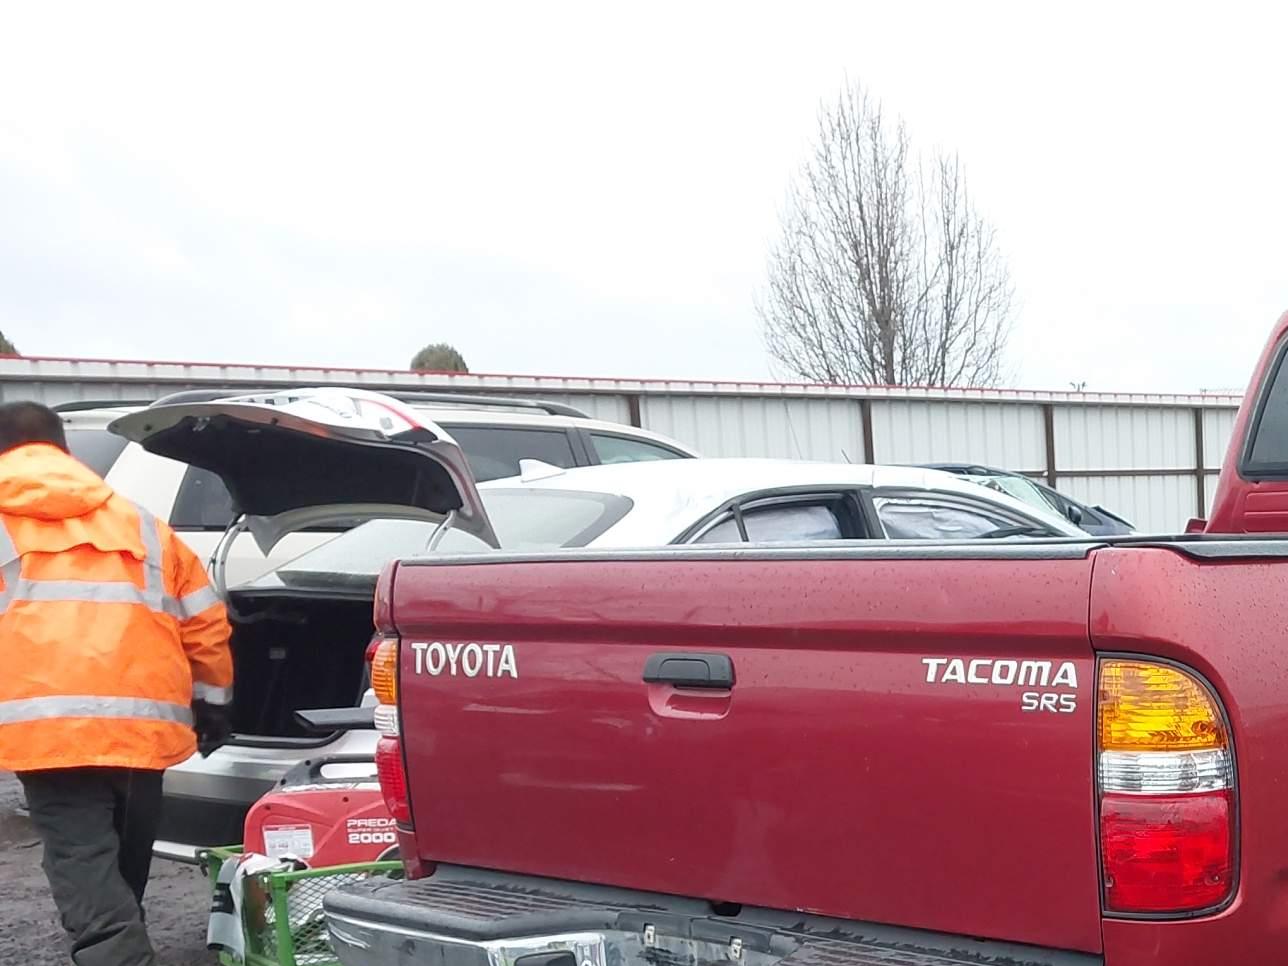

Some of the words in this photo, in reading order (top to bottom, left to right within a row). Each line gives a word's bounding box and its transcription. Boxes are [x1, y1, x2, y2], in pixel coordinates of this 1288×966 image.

[411, 641, 518, 679] TOYOTA
[921, 657, 1078, 689] TACOMA
[348, 831, 396, 844] 2000
